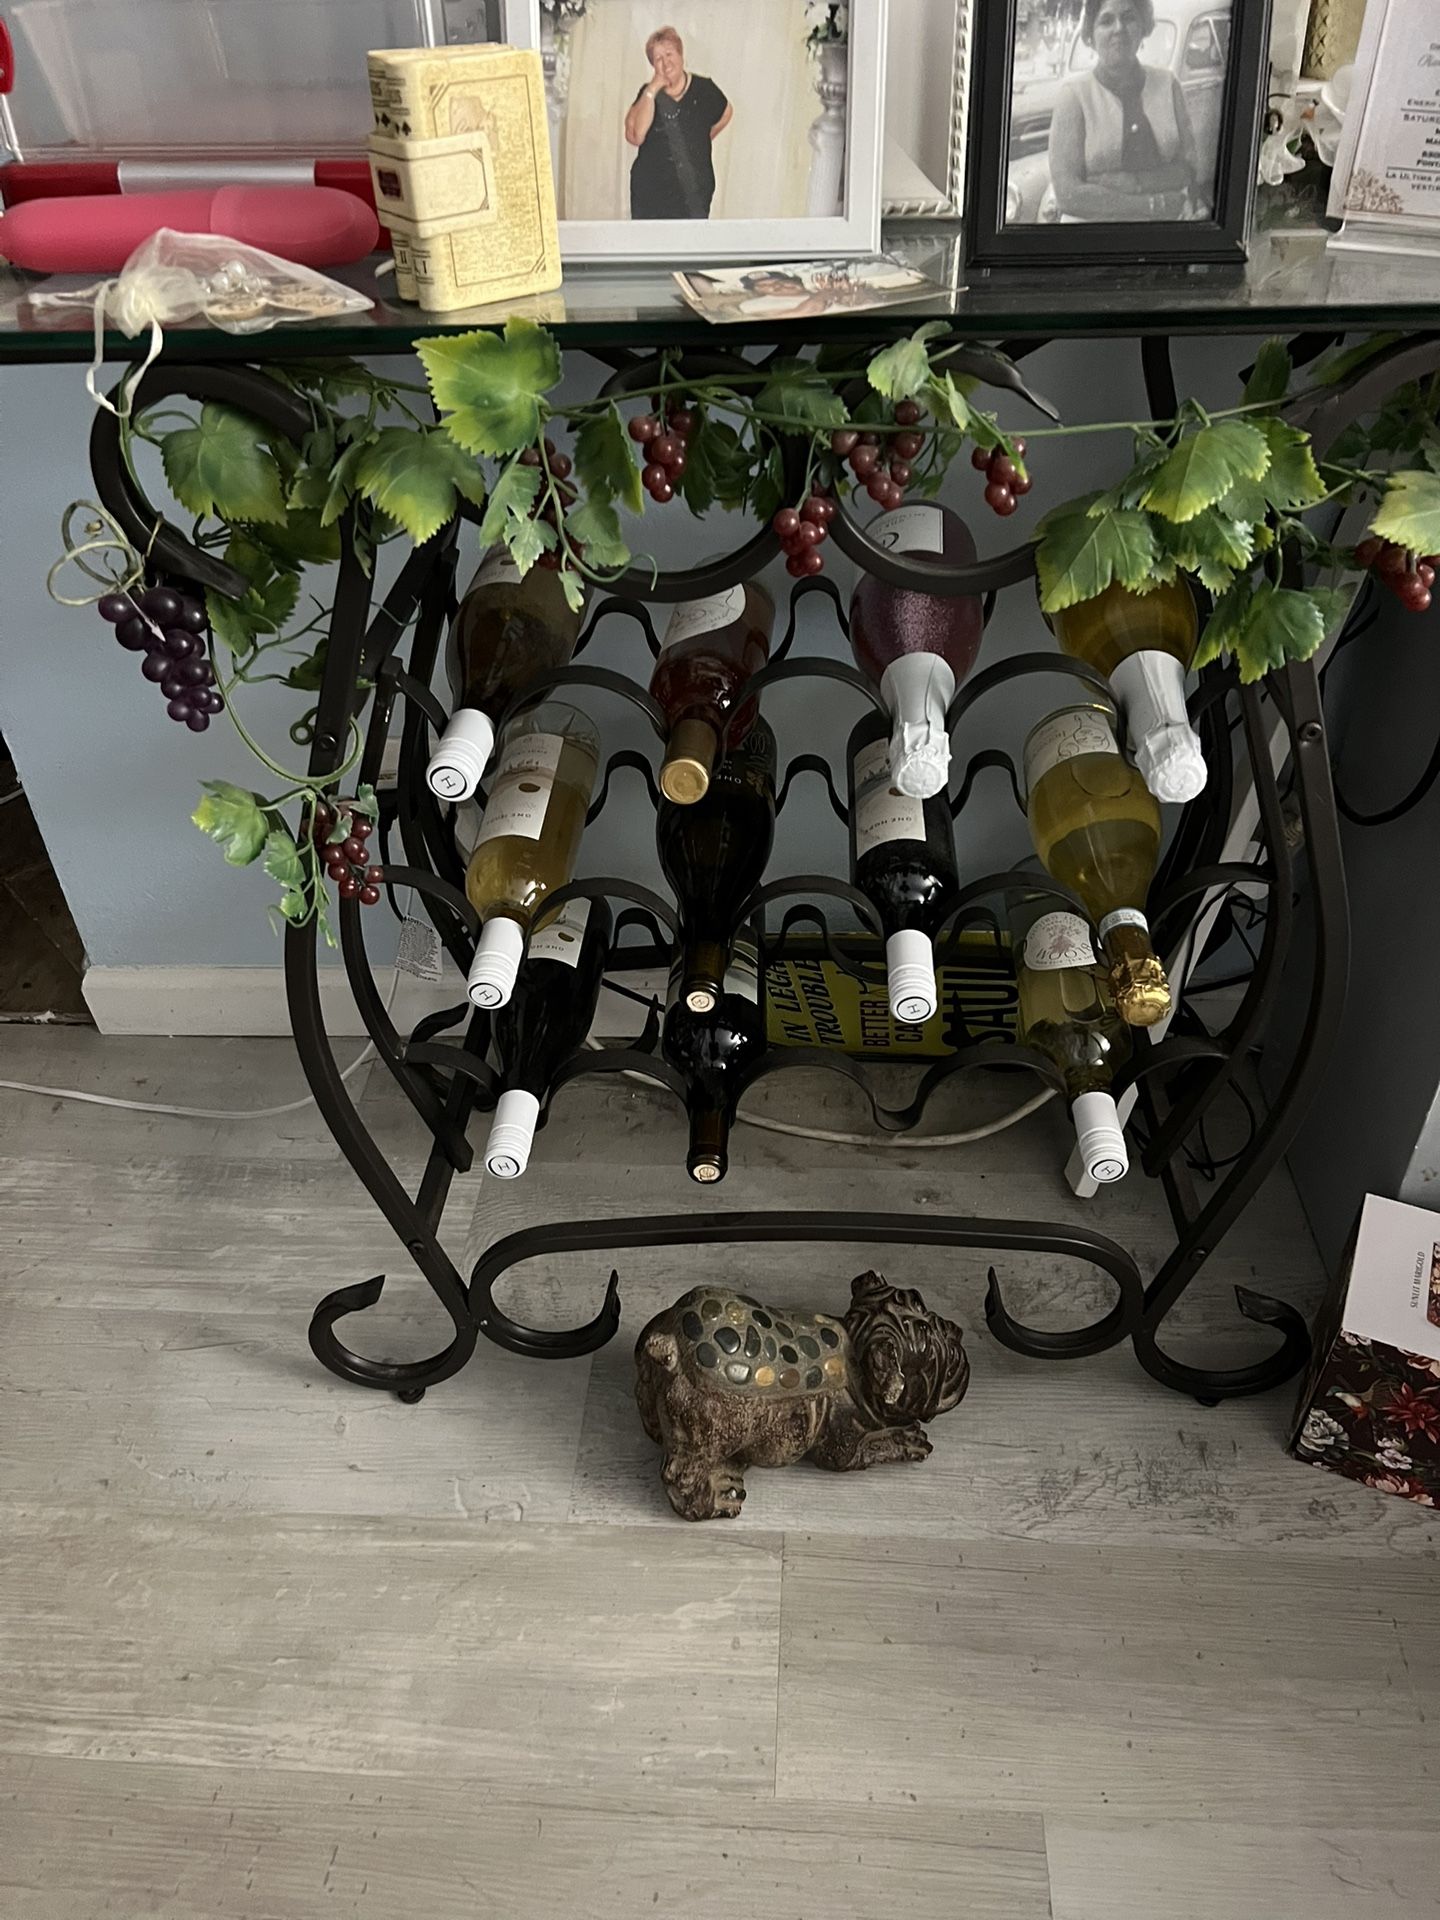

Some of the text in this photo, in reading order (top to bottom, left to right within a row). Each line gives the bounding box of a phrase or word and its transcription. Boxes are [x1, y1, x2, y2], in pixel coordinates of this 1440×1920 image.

[860, 1000, 890, 1047] BETTER
[942, 961, 1019, 1047] SAUL
[781, 1019, 814, 1043] IN
